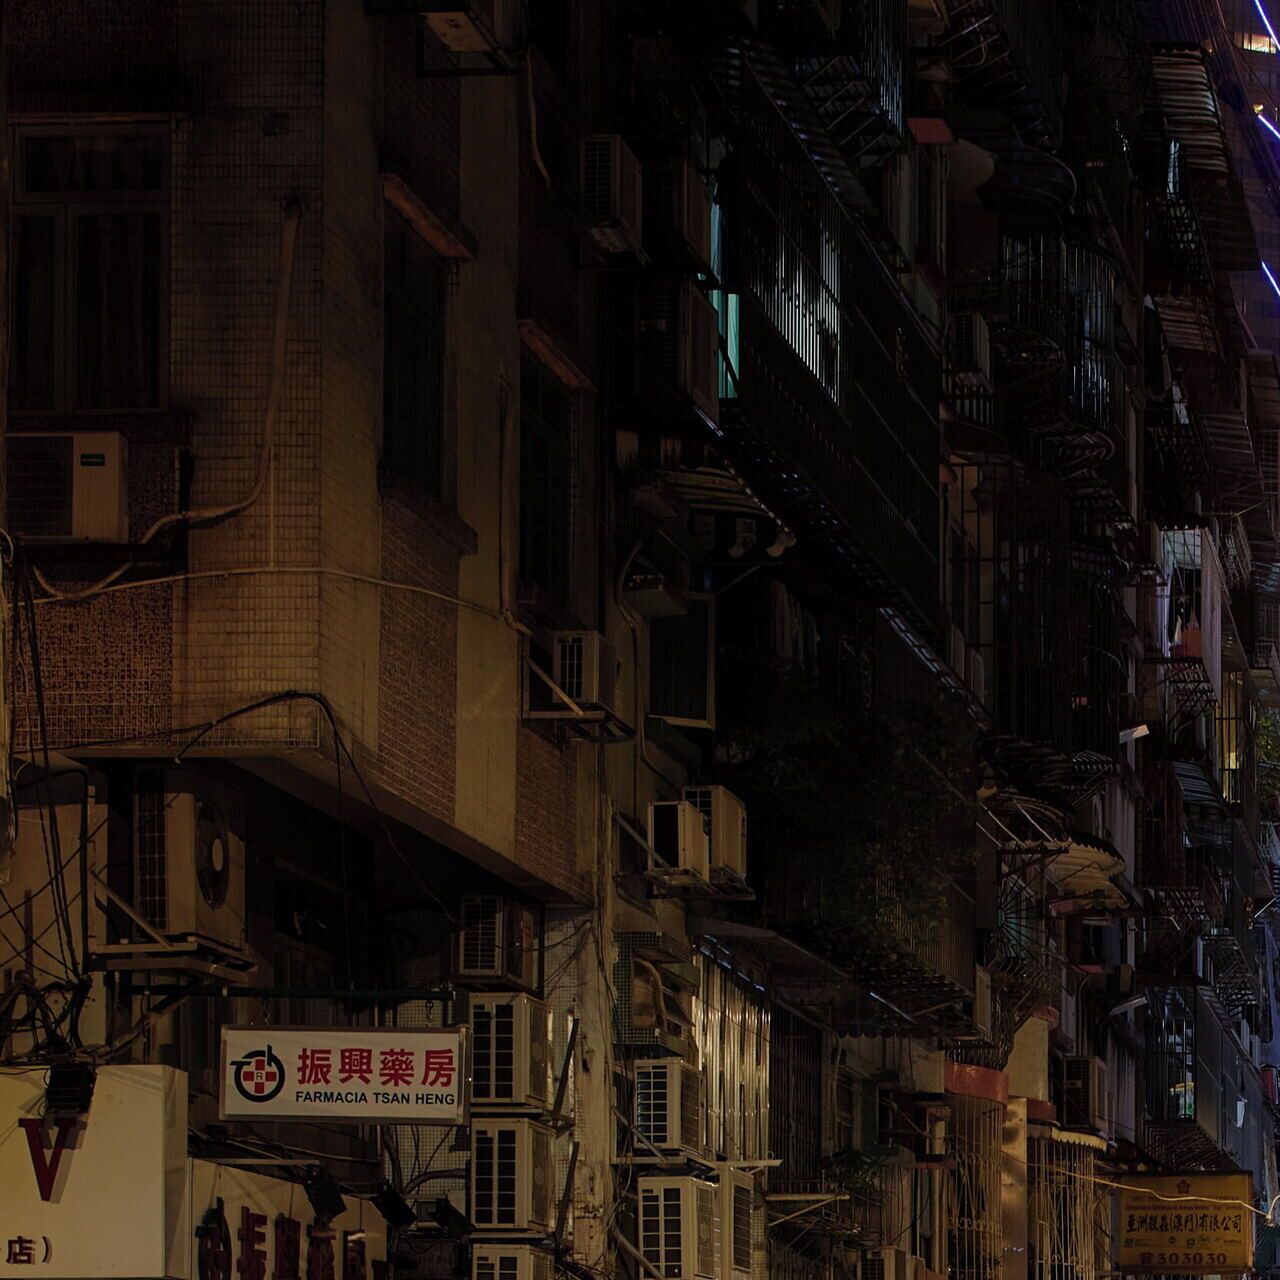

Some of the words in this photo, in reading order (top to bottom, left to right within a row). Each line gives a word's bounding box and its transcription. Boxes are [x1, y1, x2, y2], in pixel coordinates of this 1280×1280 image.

[296, 1047, 456, 1087] 振興藥房
[295, 1091, 368, 1104] FARMACIA
[373, 1092, 410, 1105] TSAN
[415, 1093, 455, 1106] HENG
